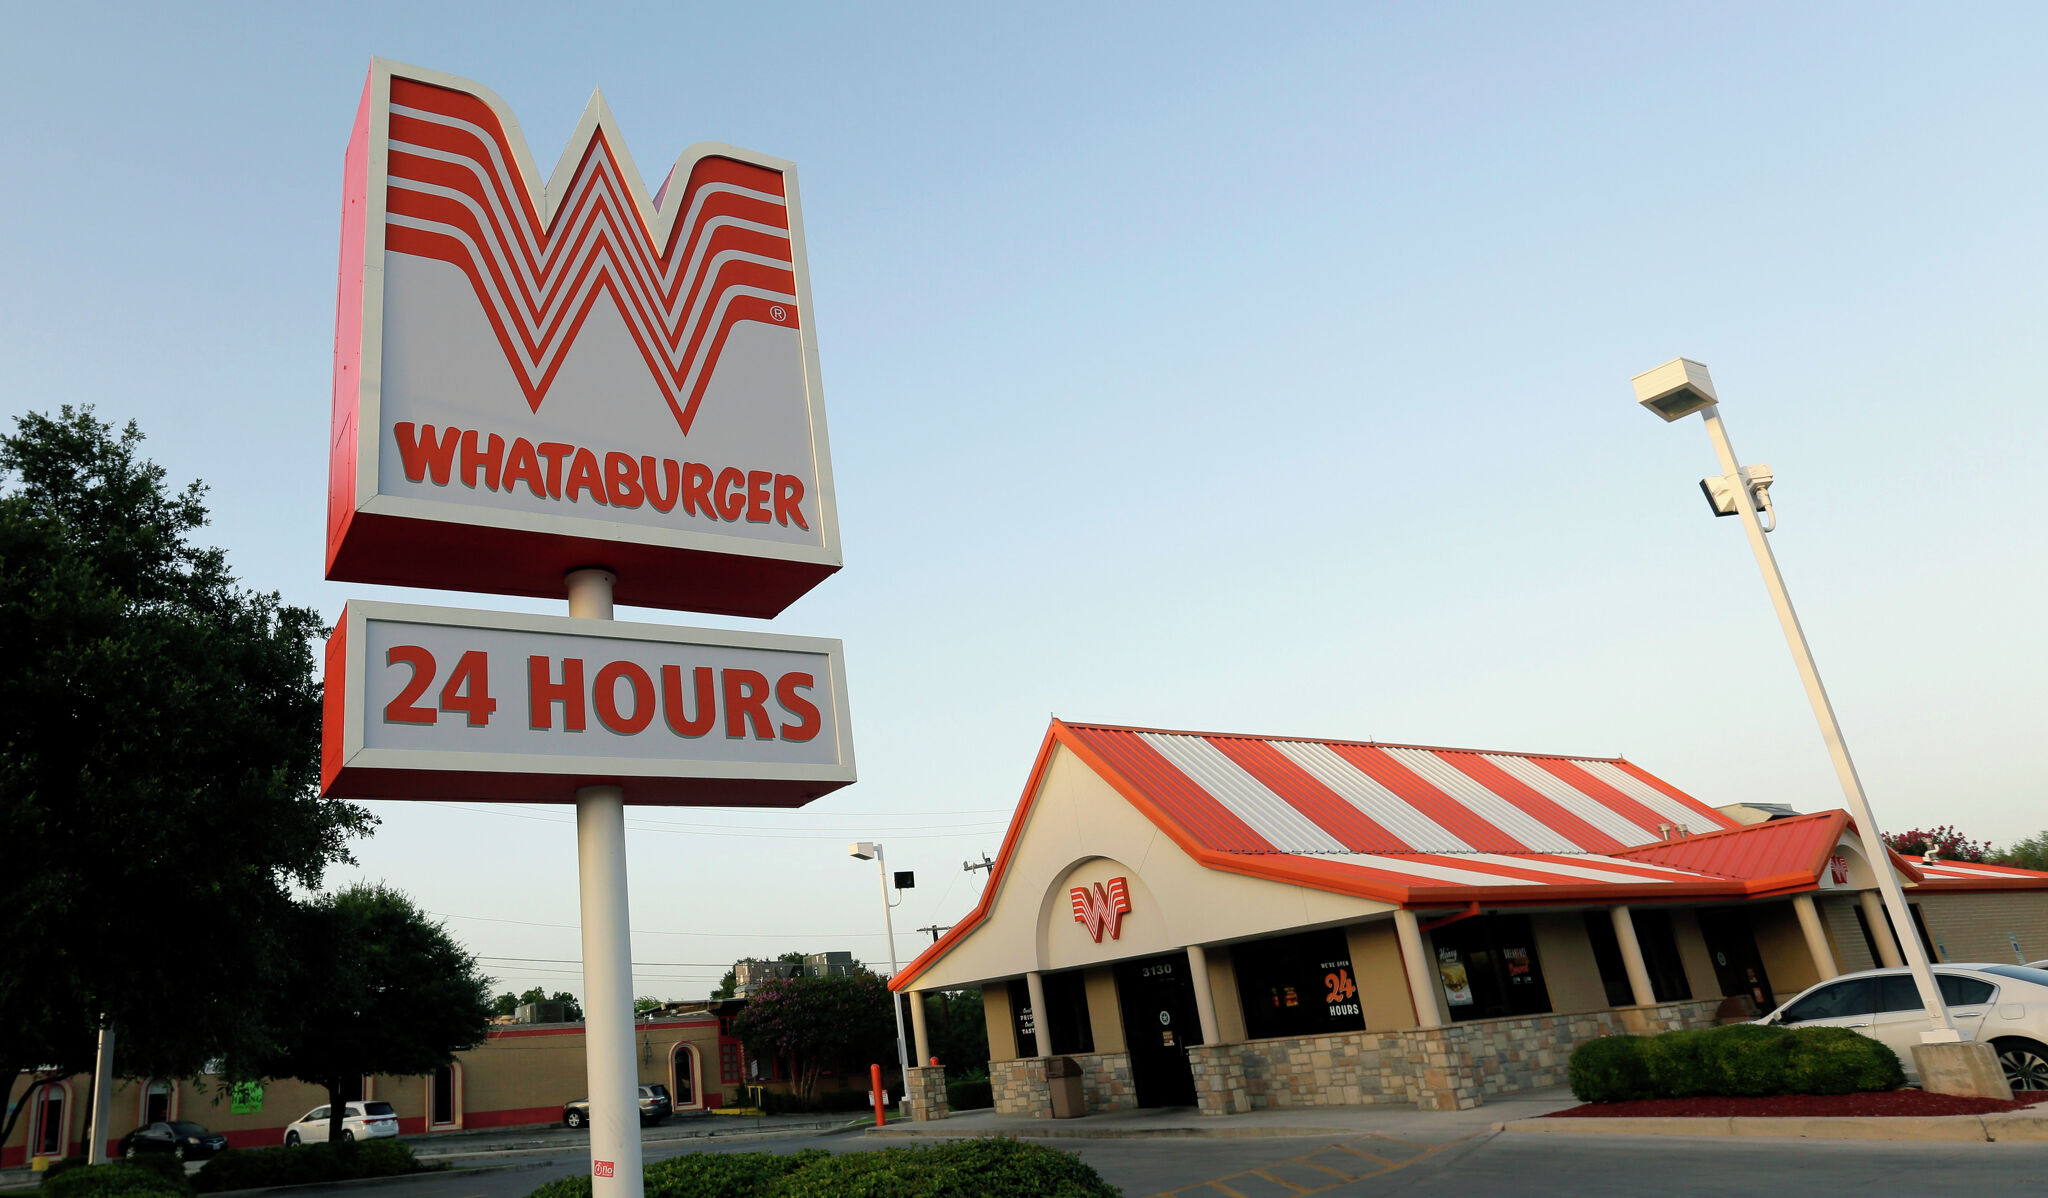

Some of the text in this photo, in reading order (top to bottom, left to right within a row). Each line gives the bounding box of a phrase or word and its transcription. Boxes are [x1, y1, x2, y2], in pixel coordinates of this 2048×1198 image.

[393, 422, 809, 531] WHATABURGER
[383, 645, 821, 742] 24 HOURS
[1141, 963, 1173, 977] 3130
[1324, 968, 1356, 1003] 24
[1329, 1004, 1360, 1016] HOURS
